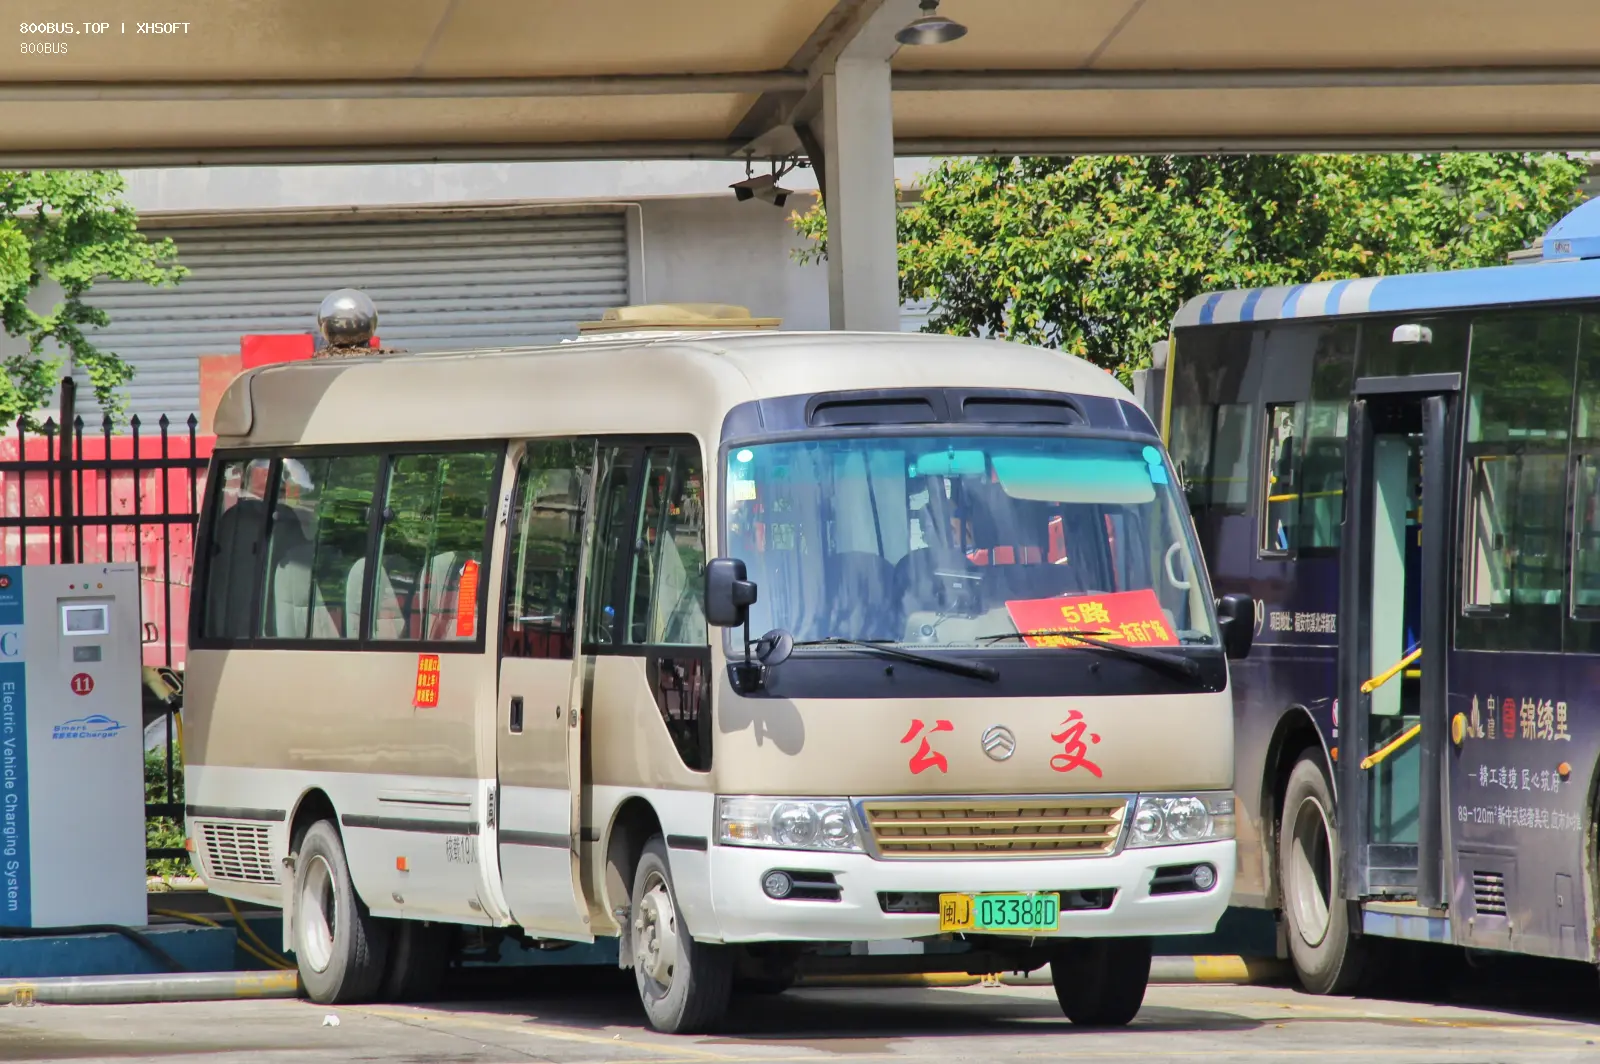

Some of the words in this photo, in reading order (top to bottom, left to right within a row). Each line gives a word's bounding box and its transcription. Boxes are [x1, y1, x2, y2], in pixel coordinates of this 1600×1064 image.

[1061, 602, 1111, 624] 5路
[1119, 619, 1169, 643] 东百广场
[75, 677, 91, 692] 11
[3, 682, 16, 734] Electric
[1519, 697, 1572, 742] 锦绣里
[3, 737, 17, 789] Vehicle
[900, 718, 955, 774] 公
[1049, 709, 1103, 778] 交
[1479, 764, 1518, 790] 精工造境
[4, 793, 19, 856] Charging
[4, 860, 20, 912] System
[943, 899, 970, 925] 闽J
[981, 899, 1056, 925] 03388D
